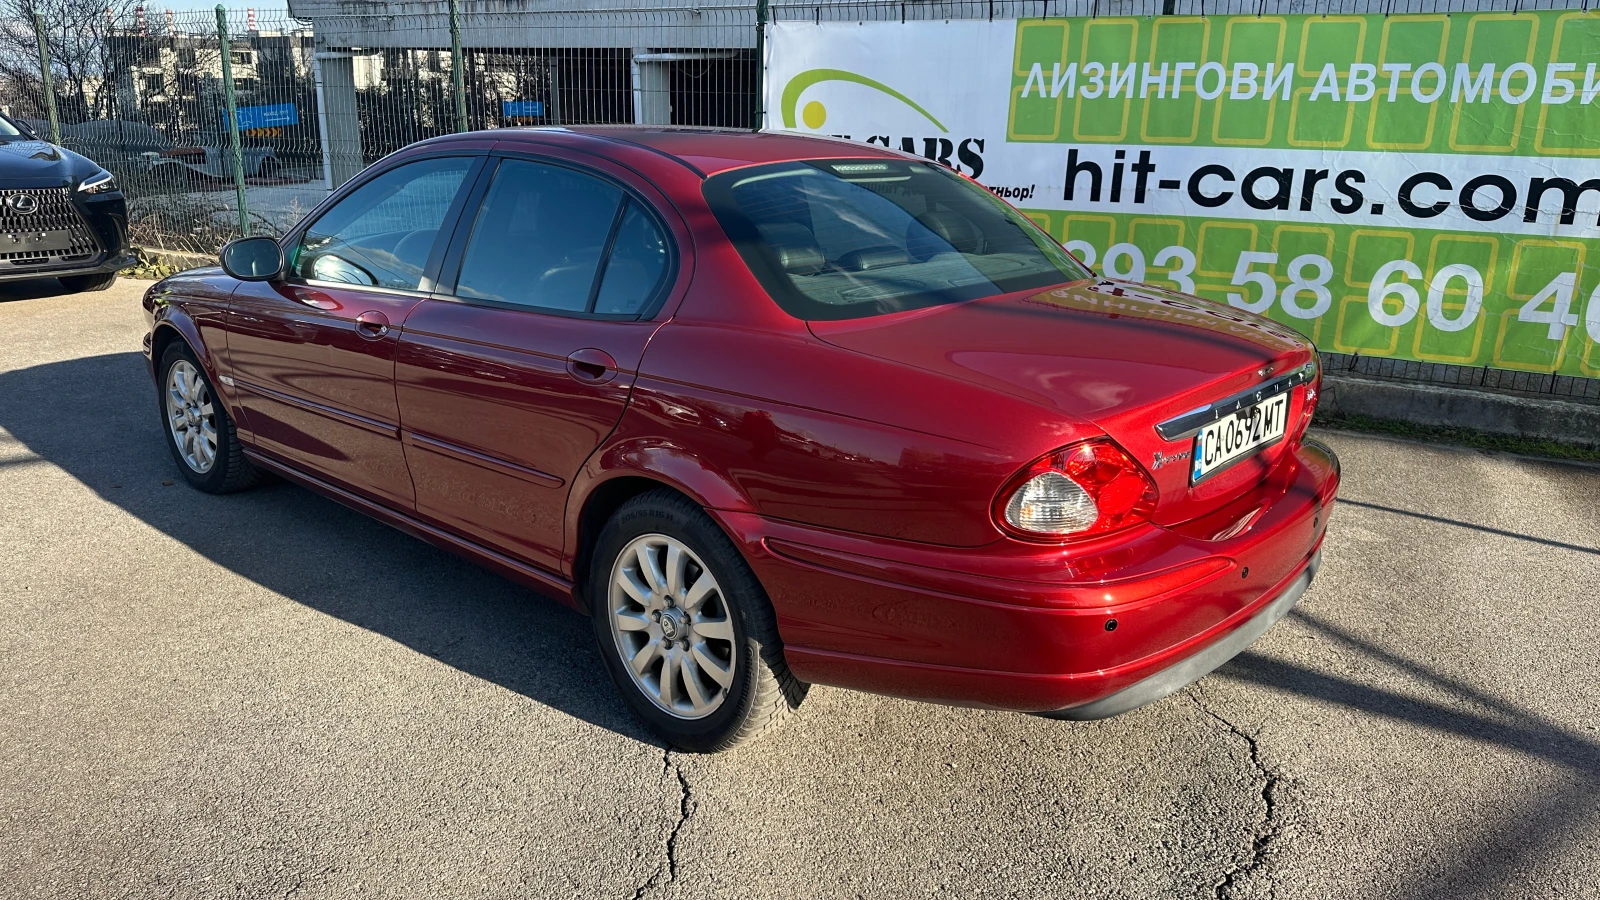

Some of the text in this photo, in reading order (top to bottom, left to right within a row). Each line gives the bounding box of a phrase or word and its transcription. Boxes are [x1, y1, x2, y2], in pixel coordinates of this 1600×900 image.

[1020, 61, 1294, 101] ЛИЗИНГОВИ
[1063, 148, 1600, 227] hit-cars.com
[1226, 250, 1334, 320] 58
[1368, 259, 1484, 333] 60
[1518, 271, 1600, 344] 4
